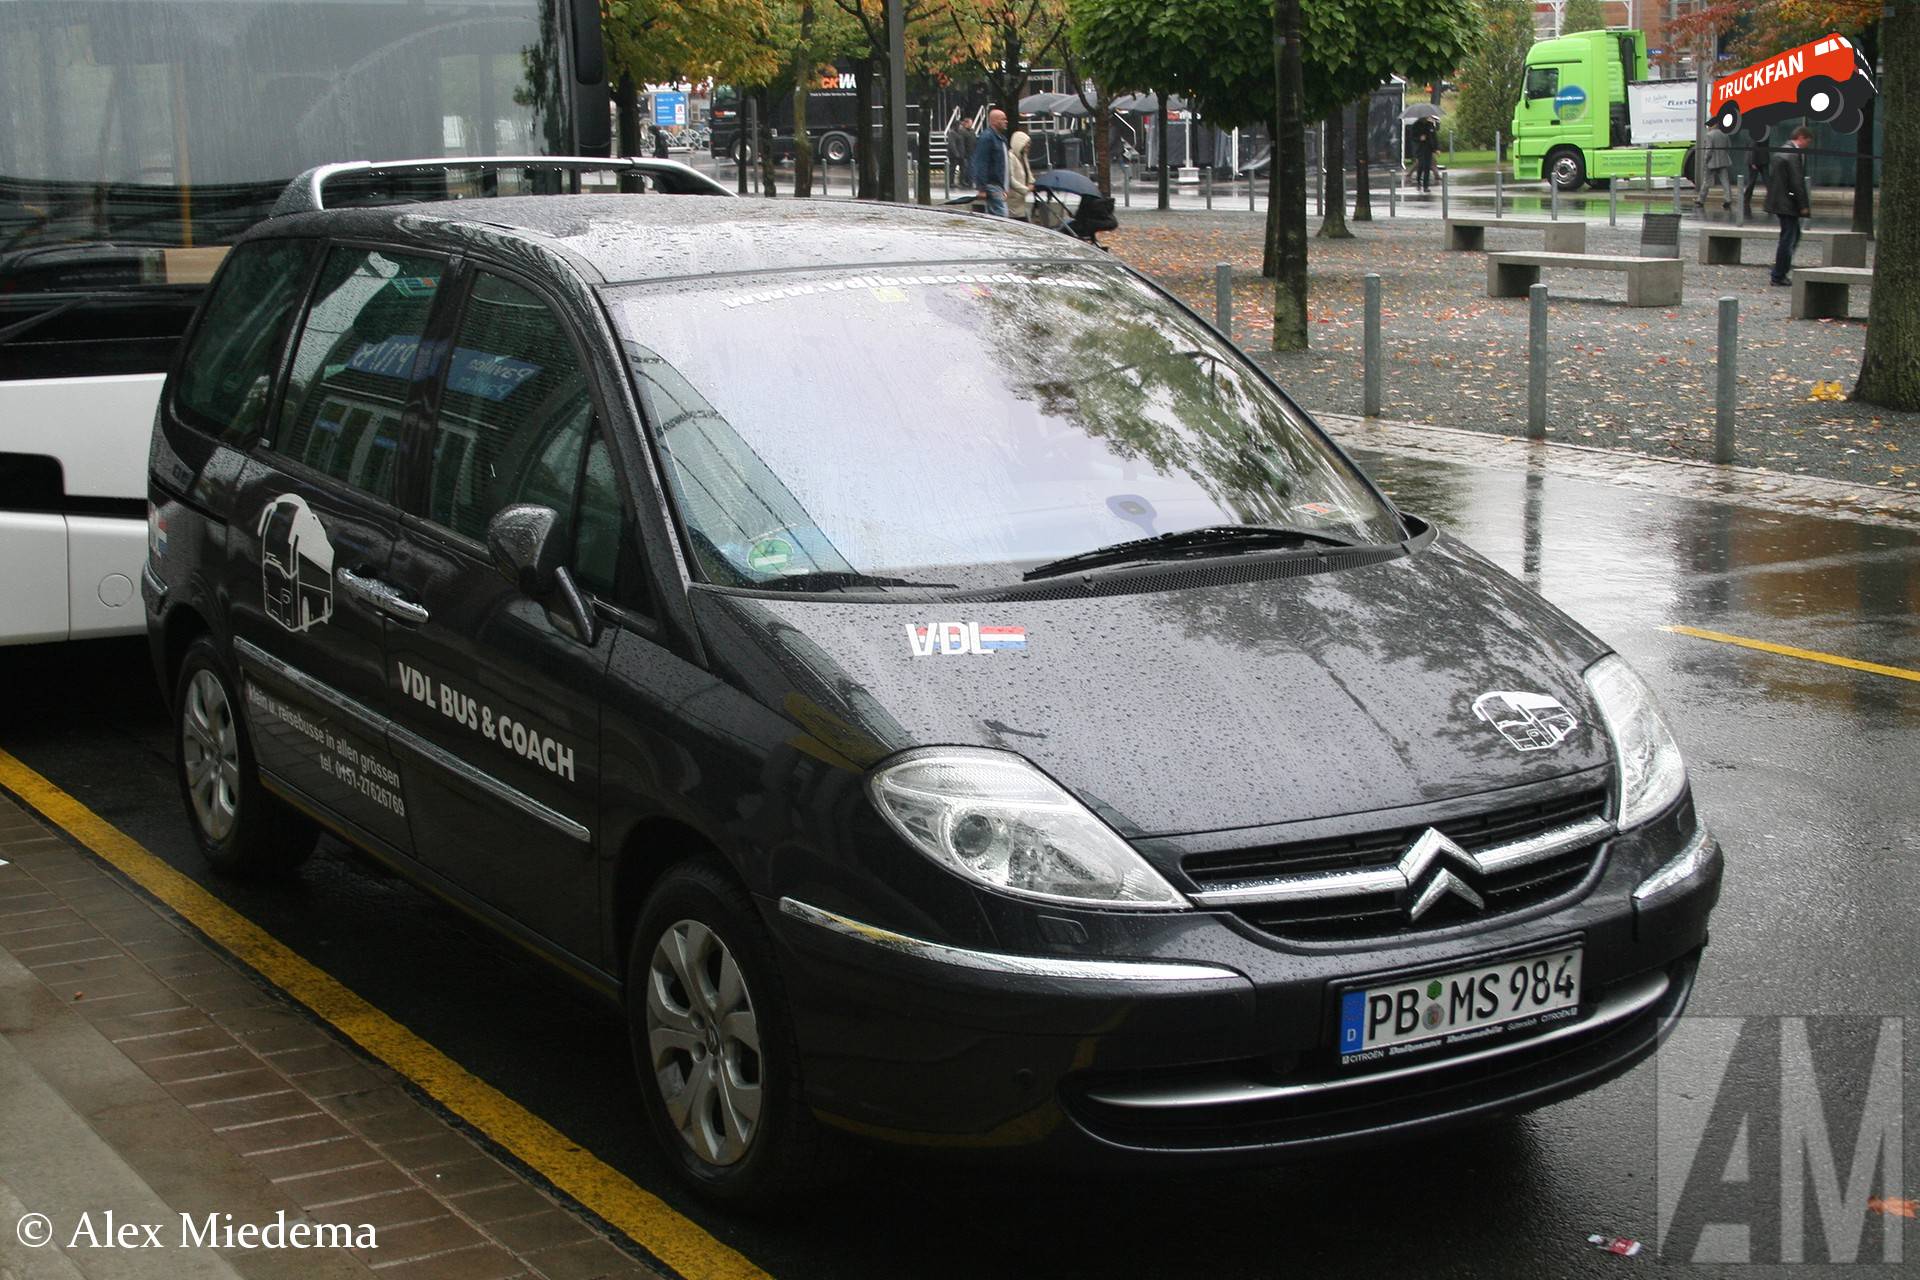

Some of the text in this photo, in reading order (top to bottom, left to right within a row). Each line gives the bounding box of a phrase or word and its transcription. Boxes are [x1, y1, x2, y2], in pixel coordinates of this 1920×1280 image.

[722, 273, 1104, 308] www.vdlbuscoach.com
[905, 622, 994, 656] VDL
[398, 661, 576, 782] VDL BUS & COACH
[278, 705, 325, 744] reisebusse
[325, 730, 335, 750] in
[336, 738, 359, 766] allen
[361, 754, 400, 788] grössen
[320, 753, 335, 774] tel.
[1369, 955, 1575, 1041] PB MS 984
[1347, 1028, 1356, 1042] D
